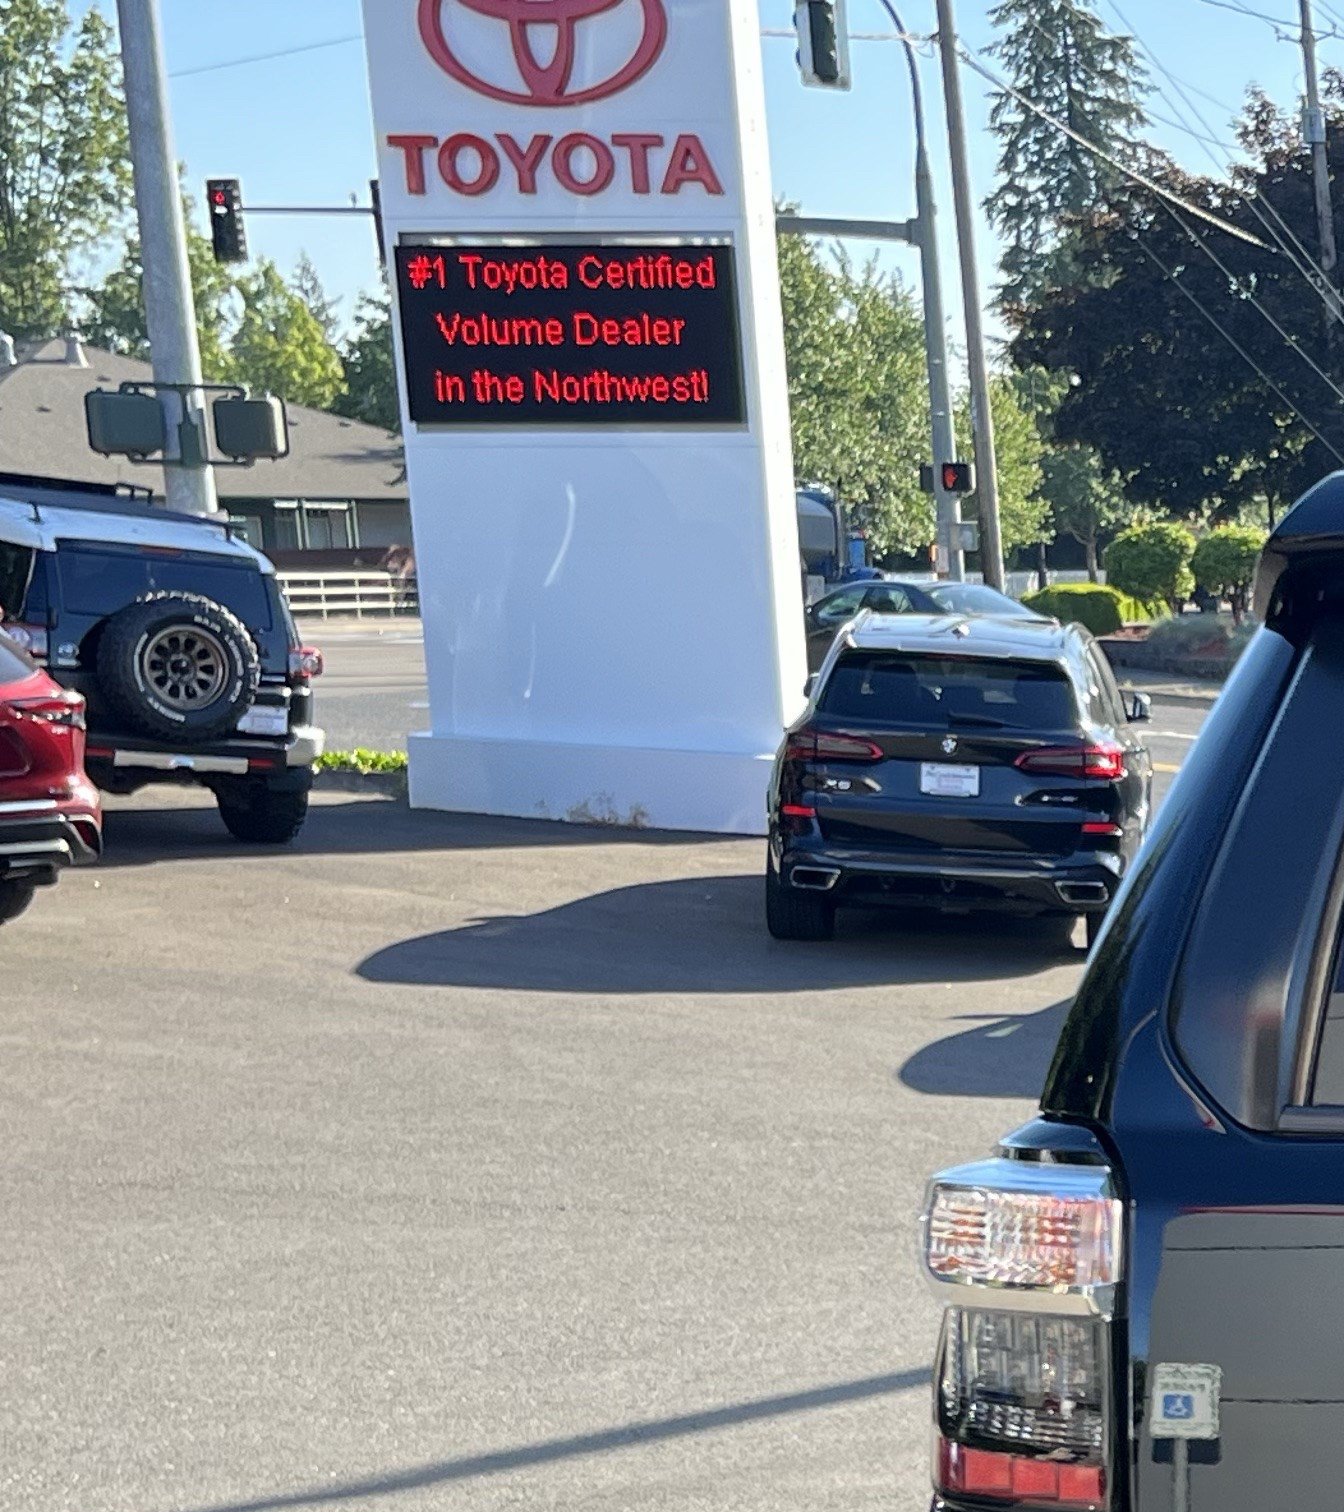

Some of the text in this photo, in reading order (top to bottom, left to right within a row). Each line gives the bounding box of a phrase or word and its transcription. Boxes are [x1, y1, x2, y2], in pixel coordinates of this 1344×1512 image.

[387, 132, 725, 195] TOYOTA
[407, 254, 717, 295] #1 Toyota Certified
[435, 311, 686, 346] Volume Dealer
[434, 368, 710, 404] in the Northwest!
